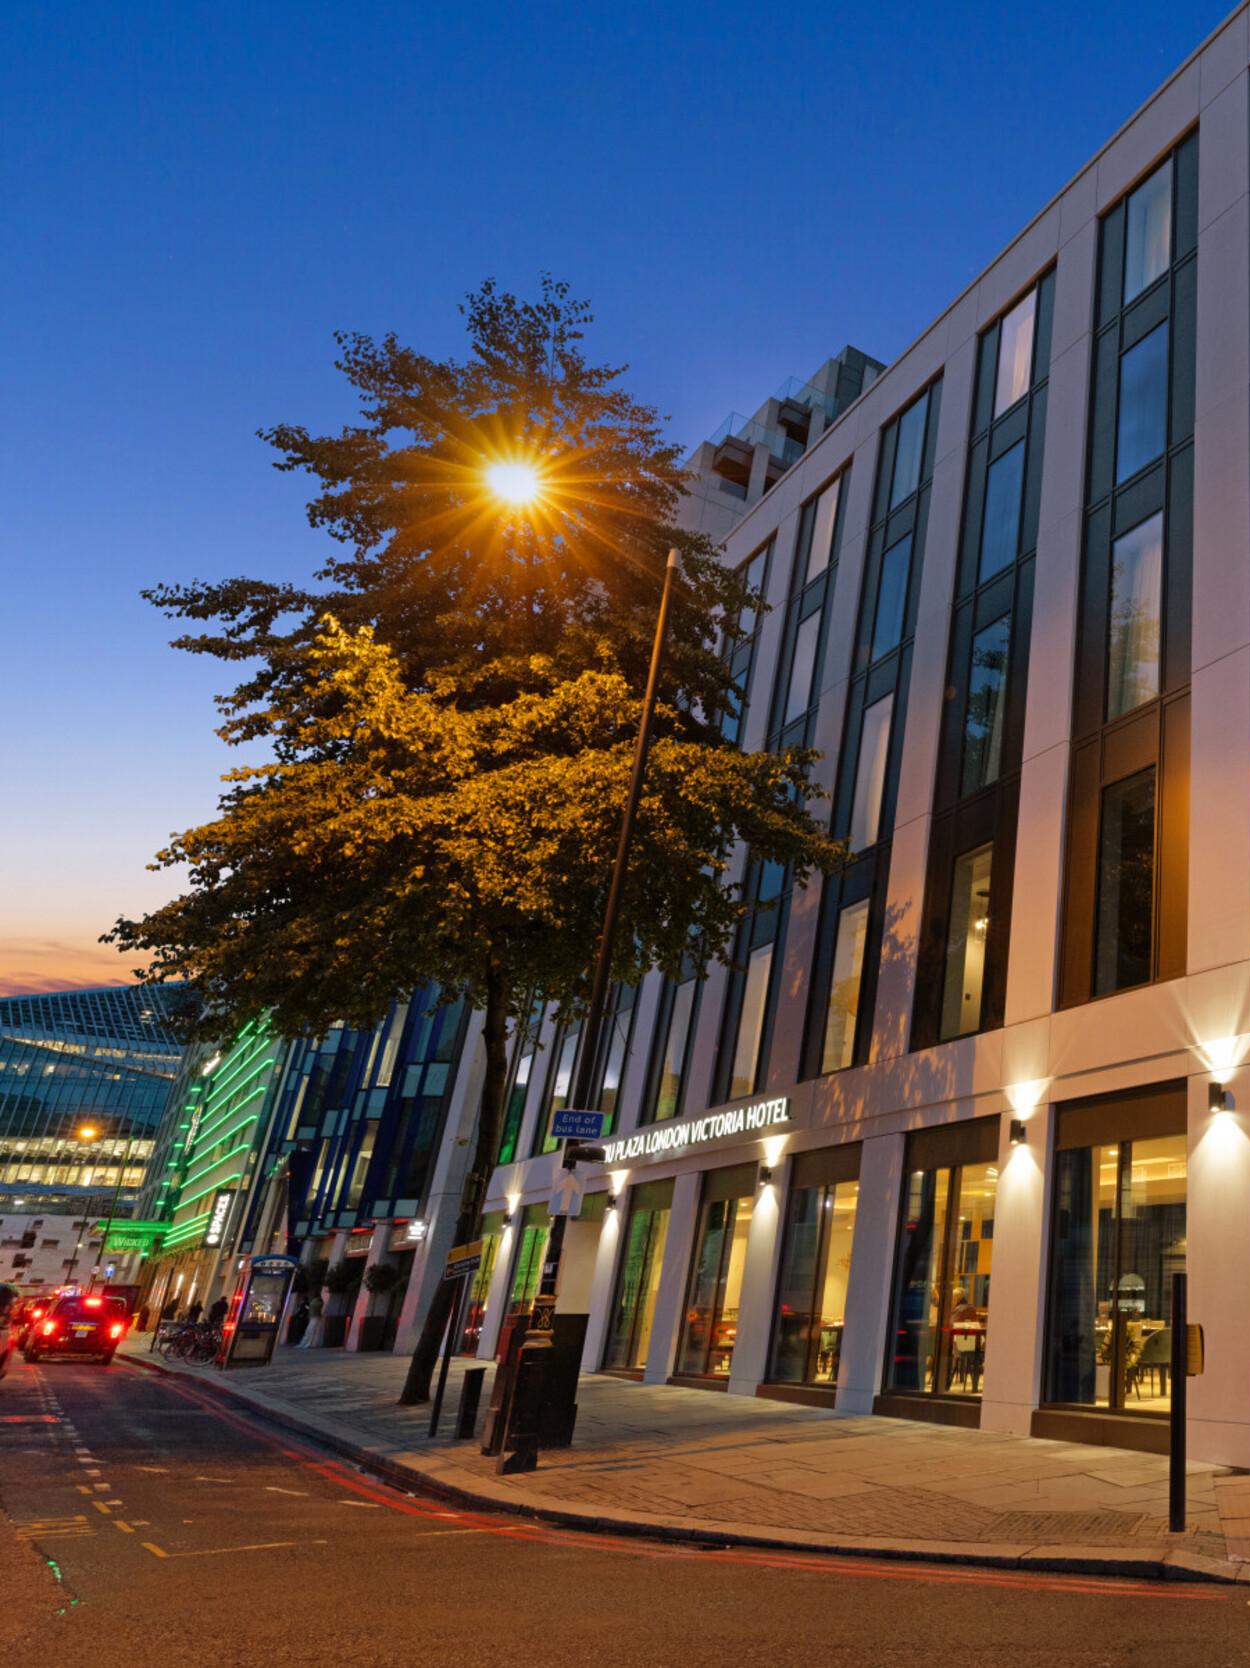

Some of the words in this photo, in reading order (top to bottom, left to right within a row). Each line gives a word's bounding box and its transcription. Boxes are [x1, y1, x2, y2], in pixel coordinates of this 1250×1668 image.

[562, 1113, 580, 1123] End
[584, 1116, 595, 1124] of
[555, 1125, 572, 1133] bus
[576, 1125, 598, 1134] lane
[614, 1134, 645, 1161] PLAZA
[645, 1122, 690, 1154] LONDON
[691, 1109, 744, 1144] VICTORIA
[745, 1096, 789, 1131] HOTEL
